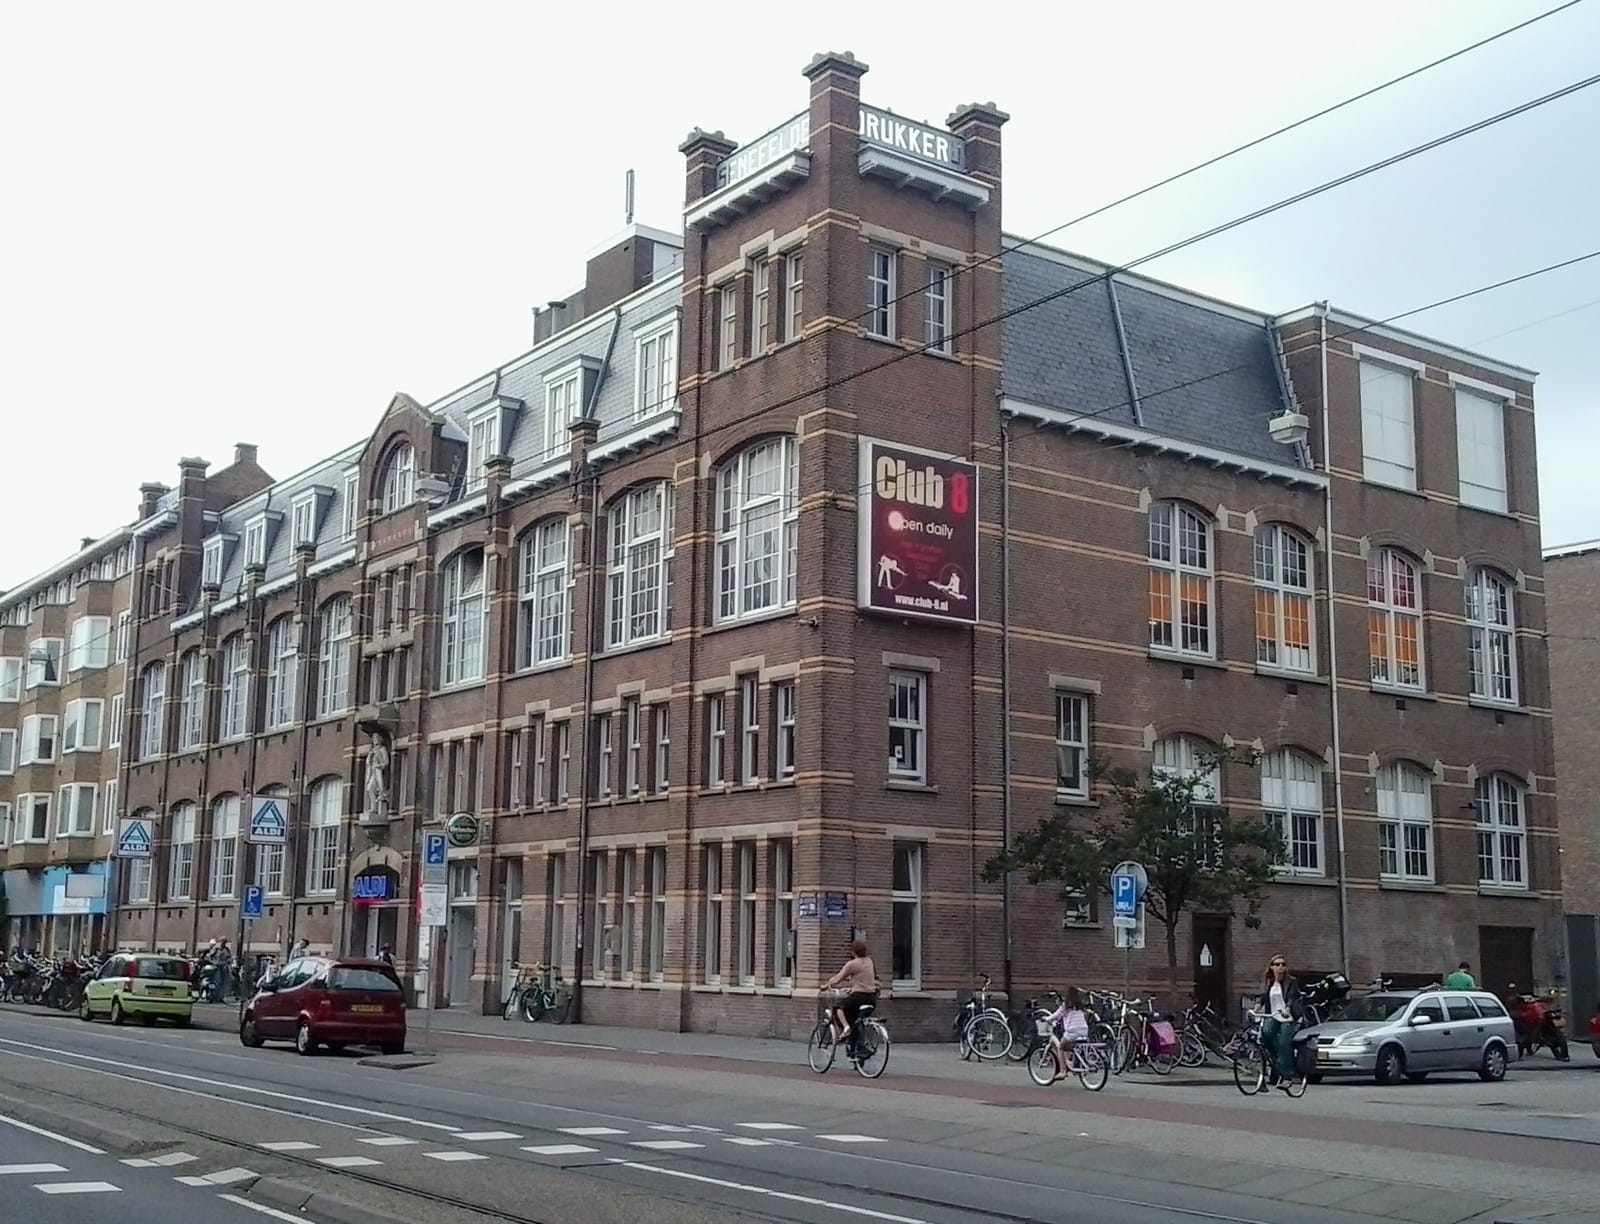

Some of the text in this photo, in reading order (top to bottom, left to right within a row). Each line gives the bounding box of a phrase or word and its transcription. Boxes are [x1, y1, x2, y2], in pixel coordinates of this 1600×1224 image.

[876, 455, 968, 514] Club 8
[926, 522, 954, 540] daily
[254, 828, 281, 836] ALDI
[431, 836, 442, 852] P
[247, 887, 260, 902] P
[353, 875, 387, 898] ALDI
[1118, 877, 1131, 897] P
